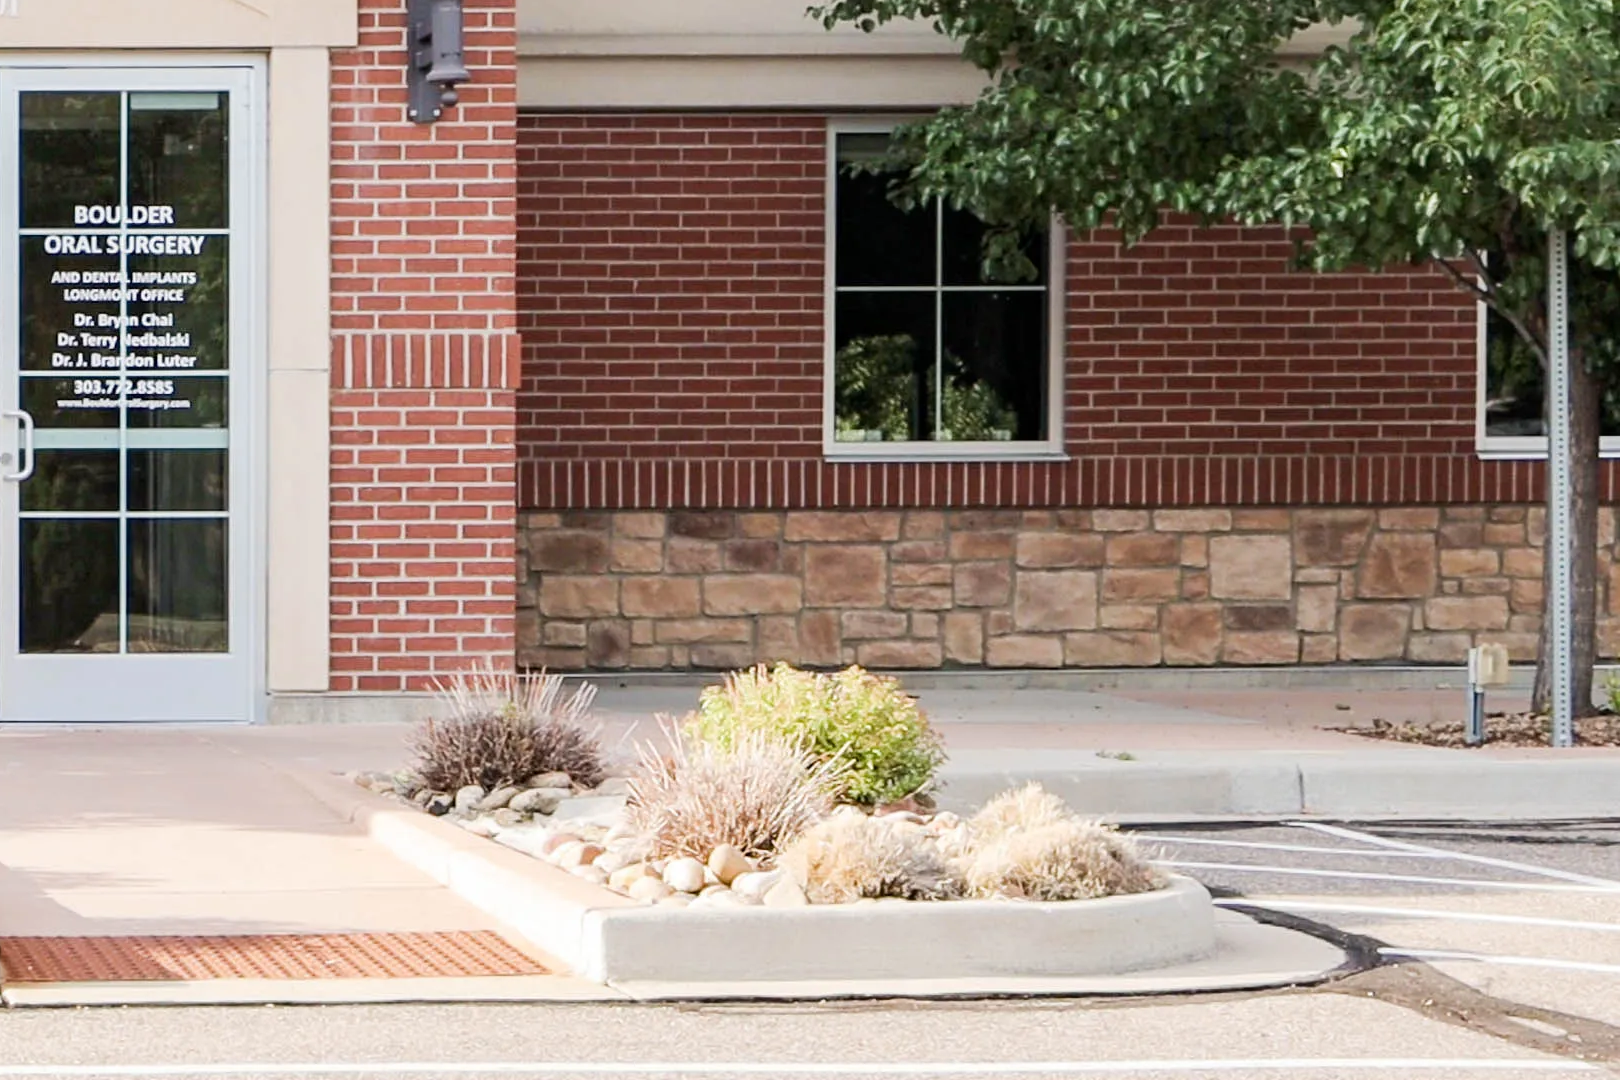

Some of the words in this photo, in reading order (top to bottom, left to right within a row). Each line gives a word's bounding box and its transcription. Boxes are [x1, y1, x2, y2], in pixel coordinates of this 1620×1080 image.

[74, 205, 174, 224] BOULDER
[44, 235, 102, 254] ORAL
[106, 235, 205, 254] SURGERY
[51, 271, 80, 284] AND
[82, 271, 130, 284] DENTAL
[132, 271, 196, 284] IMPLANTS
[64, 288, 139, 301] LONGMONT
[141, 288, 184, 301] OFFICE
[74, 313, 94, 326] Dr.
[97, 313, 138, 329] Bryan
[57, 332, 78, 347] Dr.
[80, 332, 117, 349] Terry
[51, 353, 73, 367] Dr.
[75, 353, 88, 367] J.
[91, 353, 154, 367] Brandon
[157, 353, 197, 367] Luter
